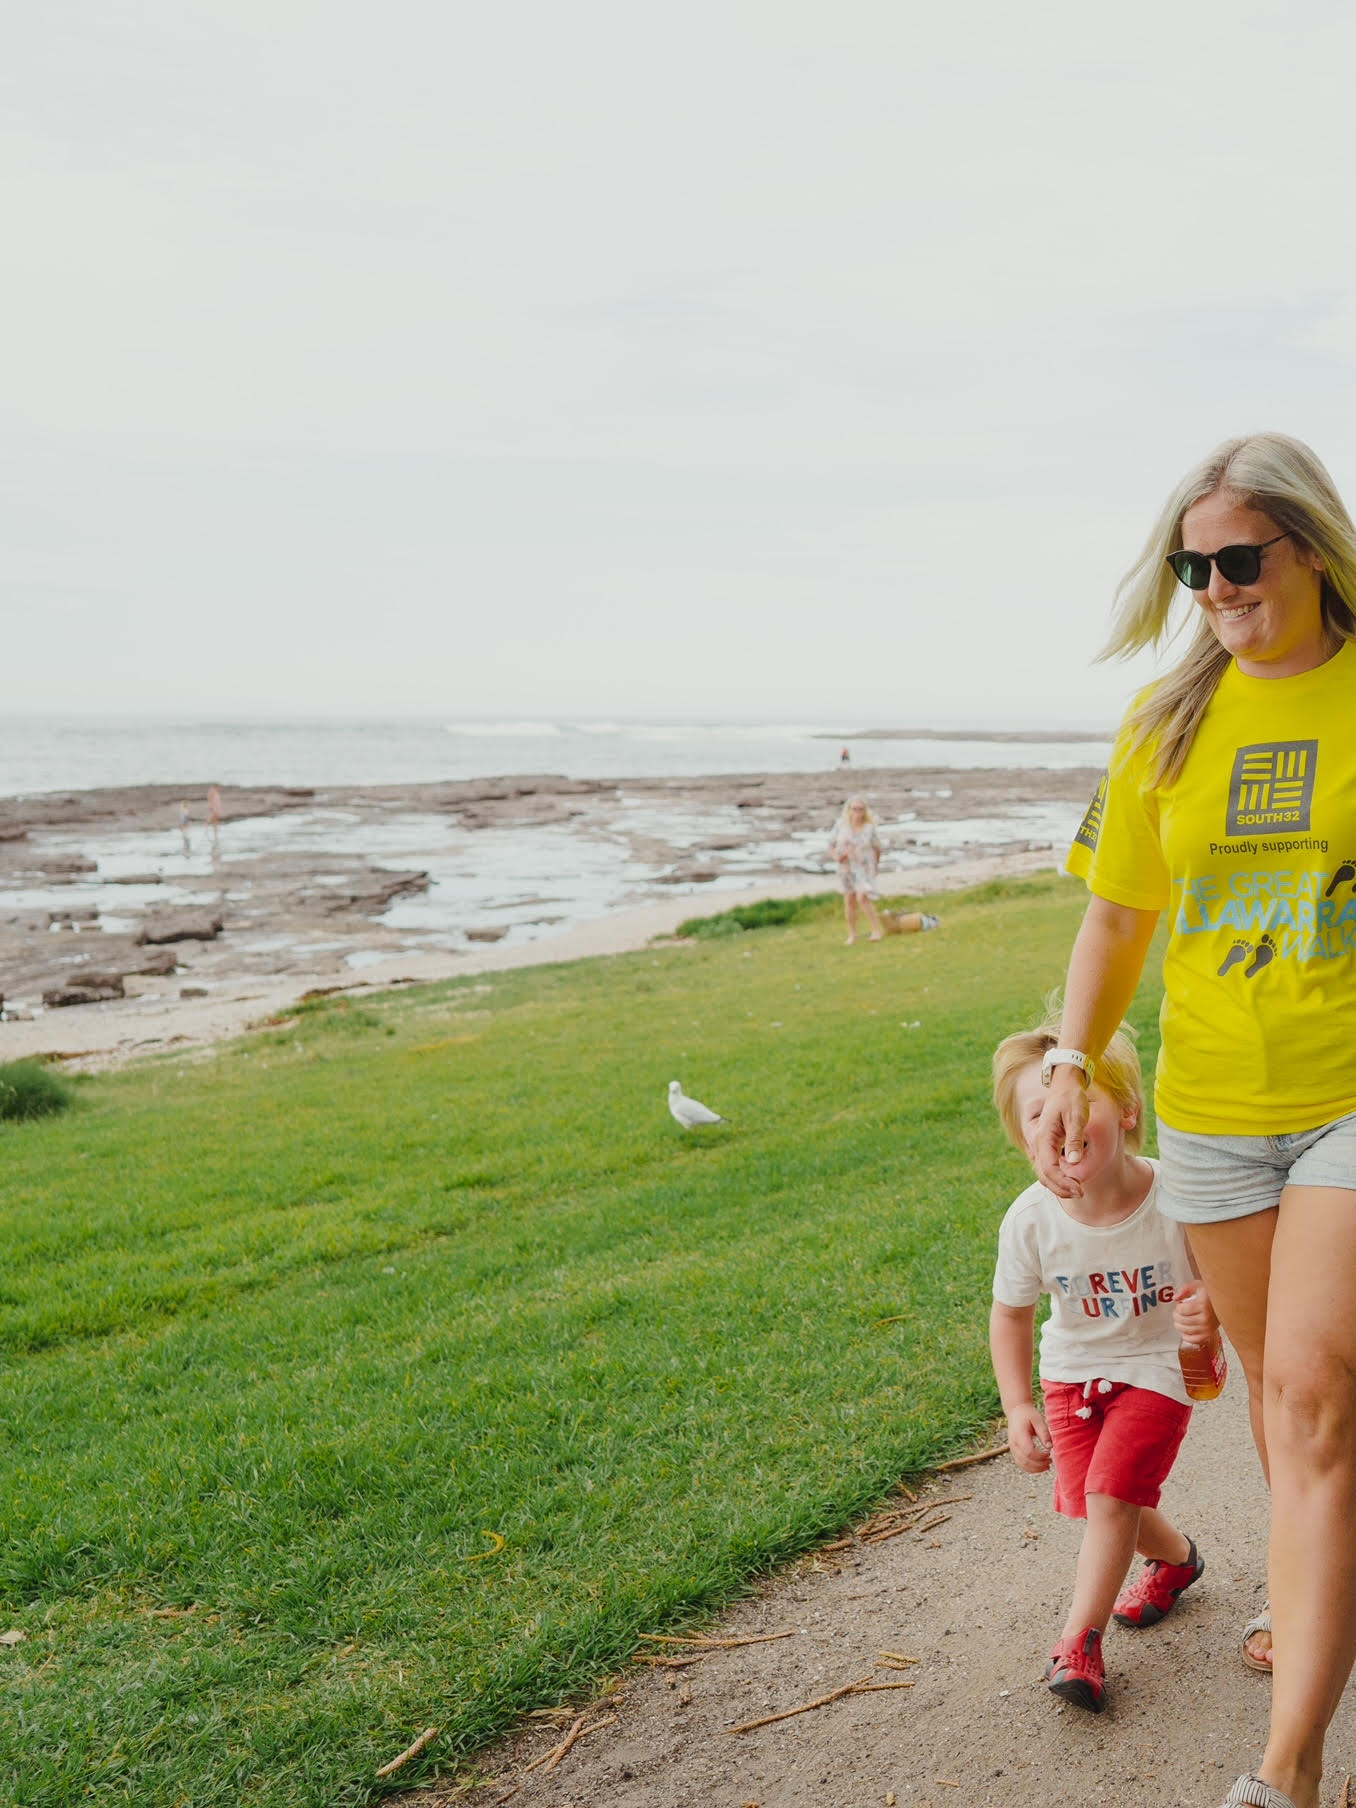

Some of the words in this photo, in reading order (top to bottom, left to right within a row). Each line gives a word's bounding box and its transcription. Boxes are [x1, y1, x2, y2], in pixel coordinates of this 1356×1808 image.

[1236, 810, 1301, 825] SOUTH32
[1209, 840, 1259, 856] Proudly
[1261, 837, 1329, 853] supporting
[1228, 871, 1331, 900] GREAT
